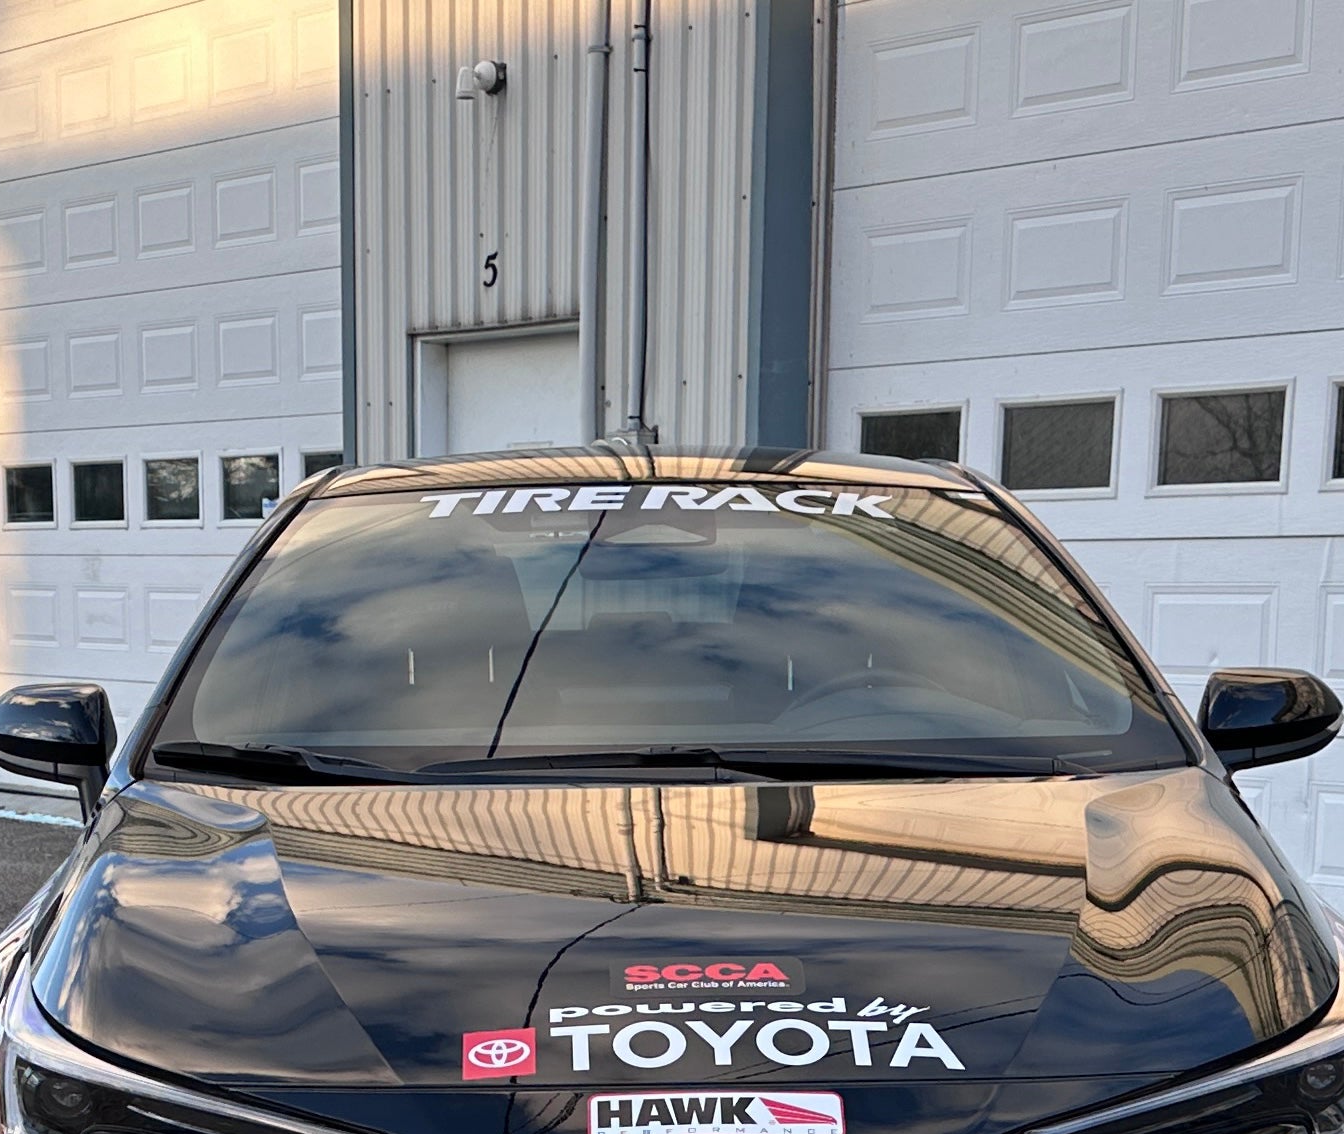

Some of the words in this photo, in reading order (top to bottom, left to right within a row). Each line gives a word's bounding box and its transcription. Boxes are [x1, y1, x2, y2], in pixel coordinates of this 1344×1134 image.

[483, 251, 498, 287] 5
[420, 486, 632, 518] TIRE
[640, 485, 895, 519] RACK
[624, 962, 789, 983] SCCA
[625, 983, 665, 991] Sports
[721, 980, 734, 988] of
[549, 997, 846, 1023] powered
[856, 997, 930, 1025] by
[549, 1018, 966, 1071] TOYOTA
[597, 1097, 758, 1128] HAWK
